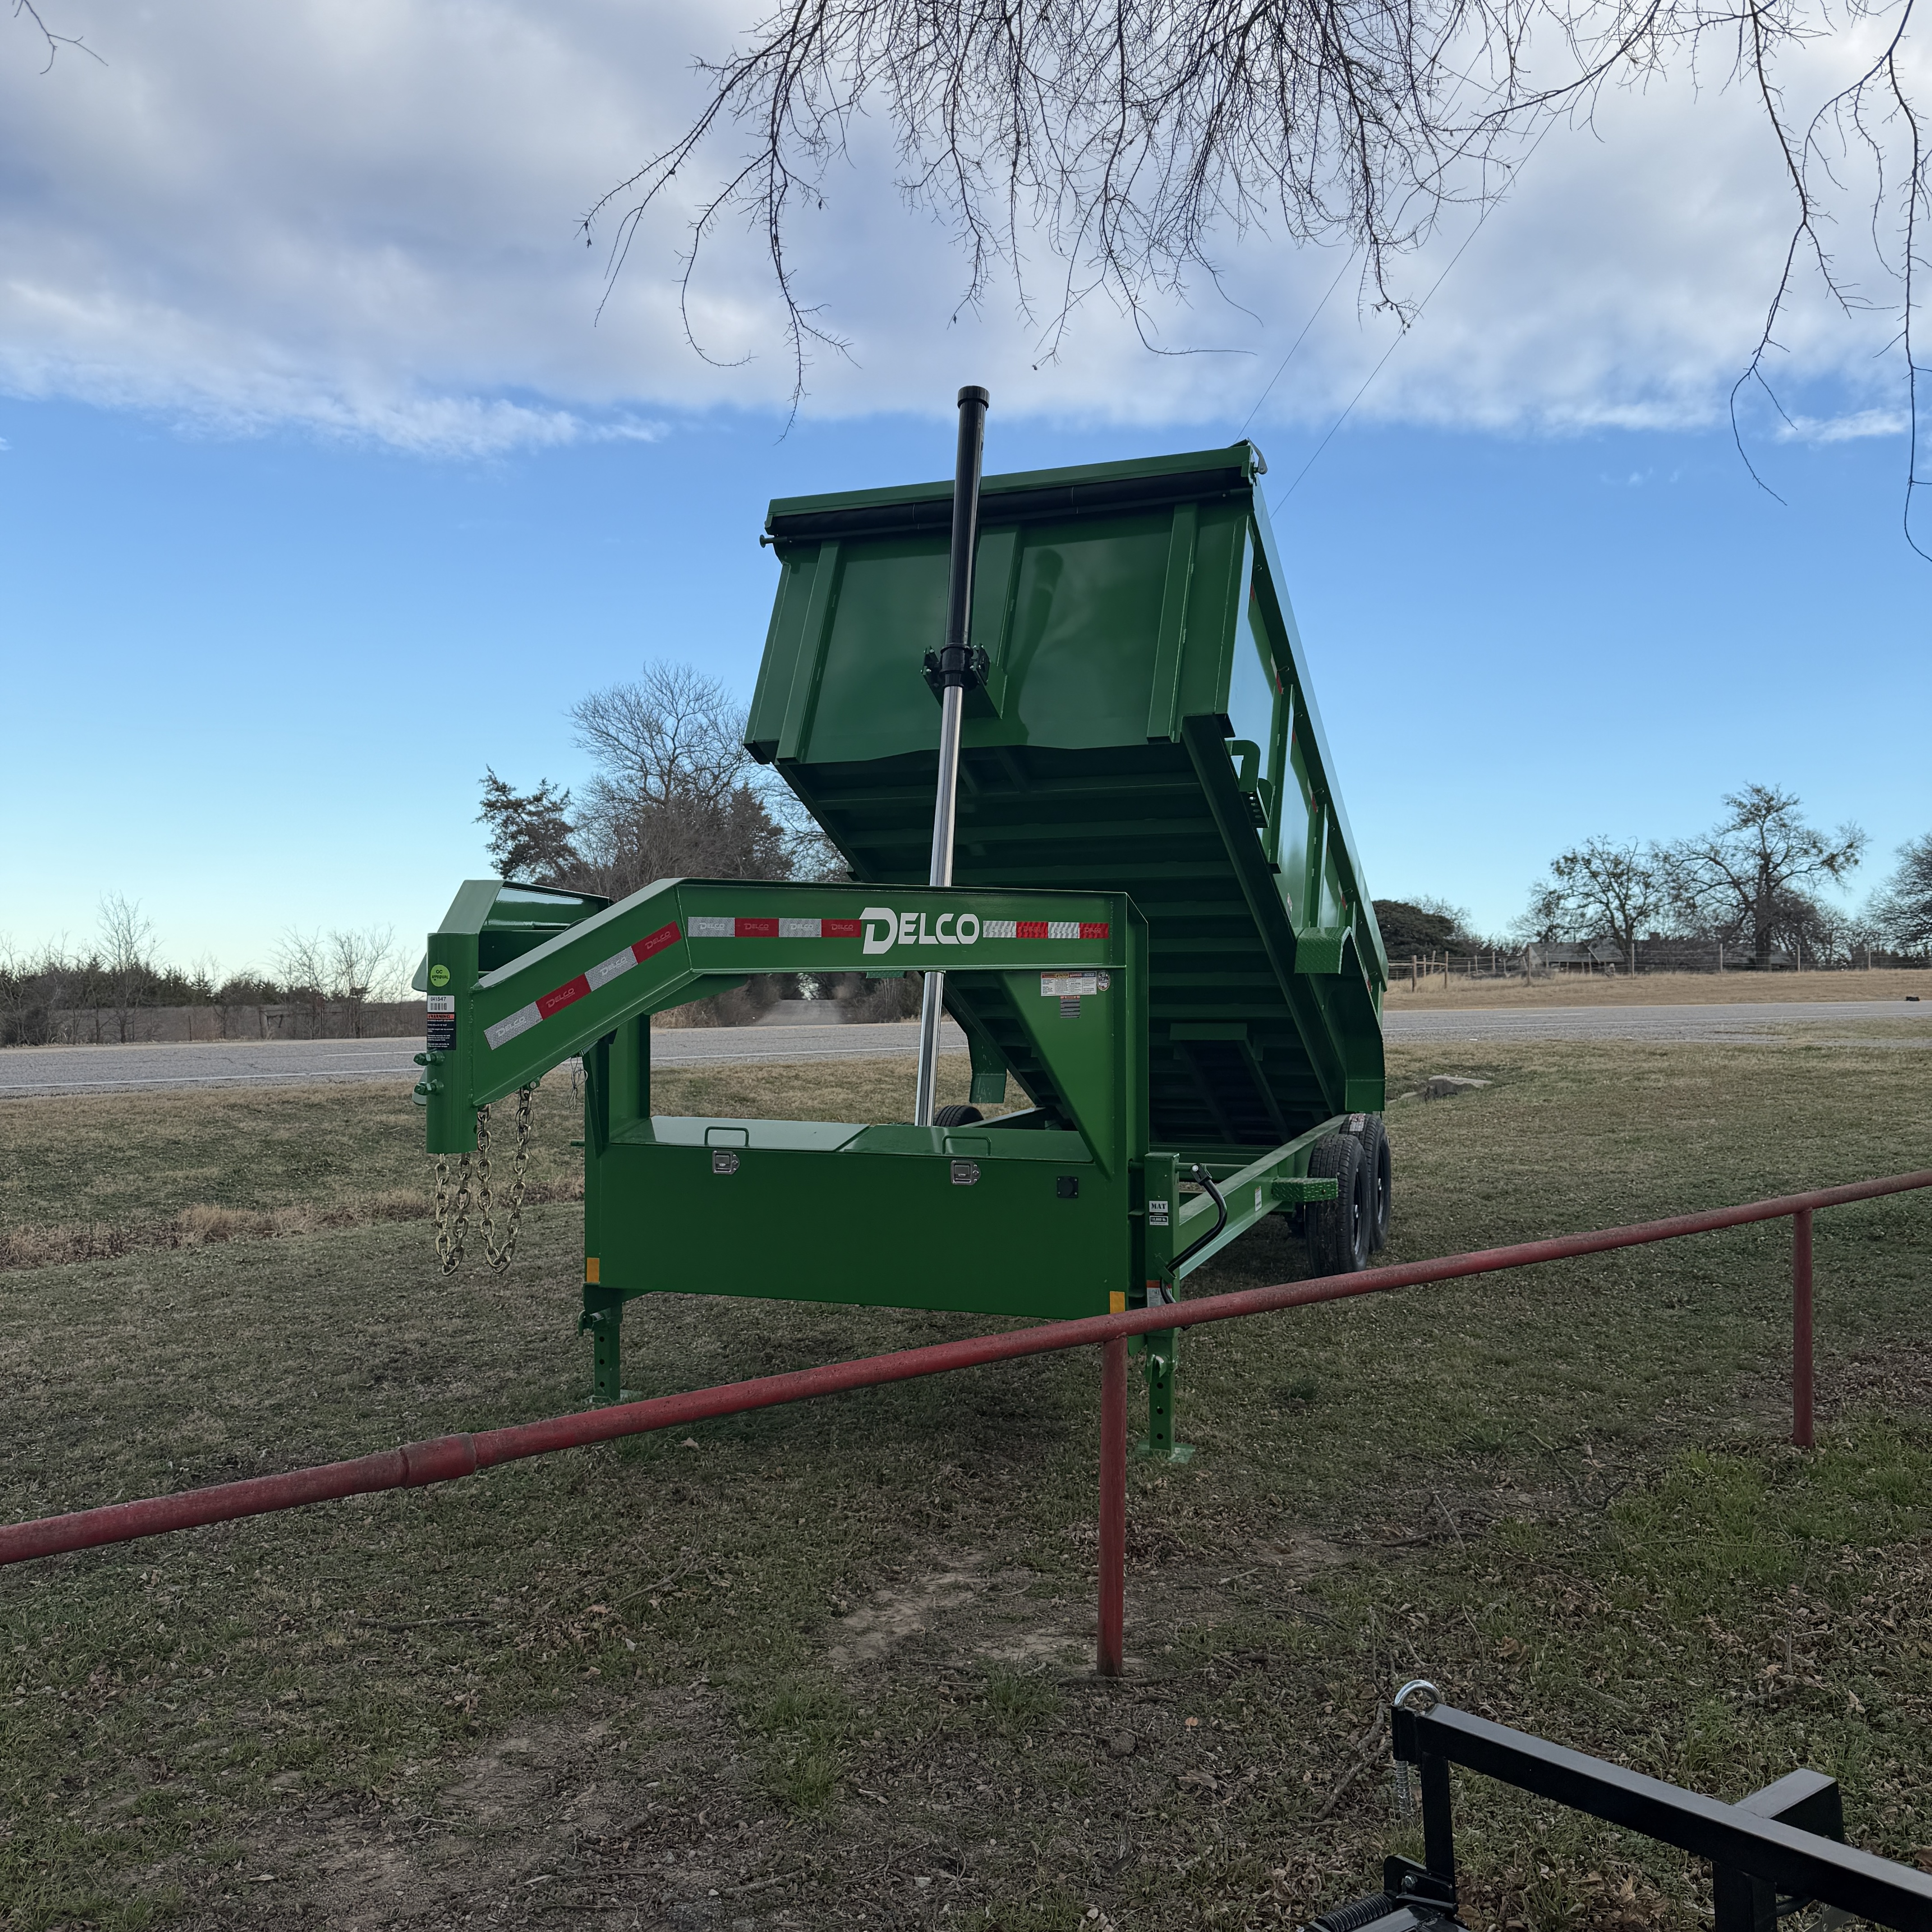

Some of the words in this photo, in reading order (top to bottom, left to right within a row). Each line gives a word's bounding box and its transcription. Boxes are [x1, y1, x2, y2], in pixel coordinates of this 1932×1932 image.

[645, 931, 670, 949] DELCO
[859, 907, 980, 954] DELCO
[600, 957, 626, 976] DELCO
[546, 988, 574, 1007] DELCO
[496, 1017, 525, 1037] DELCO
